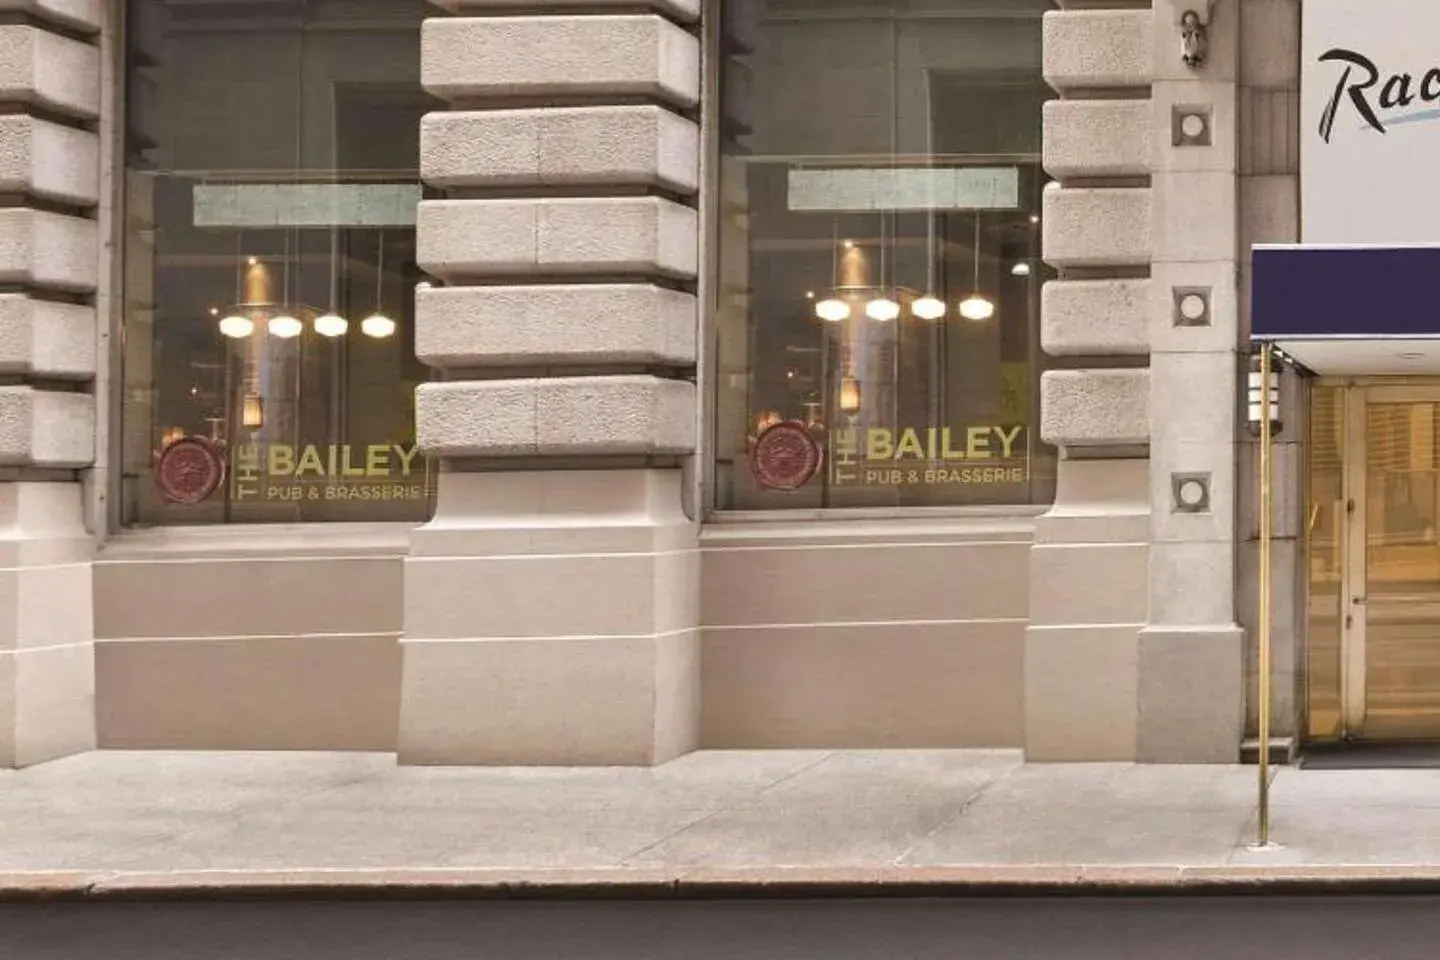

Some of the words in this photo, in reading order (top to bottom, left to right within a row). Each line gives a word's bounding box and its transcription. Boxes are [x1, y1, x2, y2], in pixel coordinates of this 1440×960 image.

[837, 427, 857, 484] THE
[867, 426, 1021, 460] BAILEY
[237, 444, 258, 500] THE
[268, 444, 418, 476] BAILEY
[866, 469, 900, 484] PUB
[907, 468, 919, 483] &
[925, 468, 1023, 483] BRASSERIE
[267, 485, 302, 500] PUB
[308, 484, 320, 499] &
[325, 484, 421, 499] BRASSERIE
